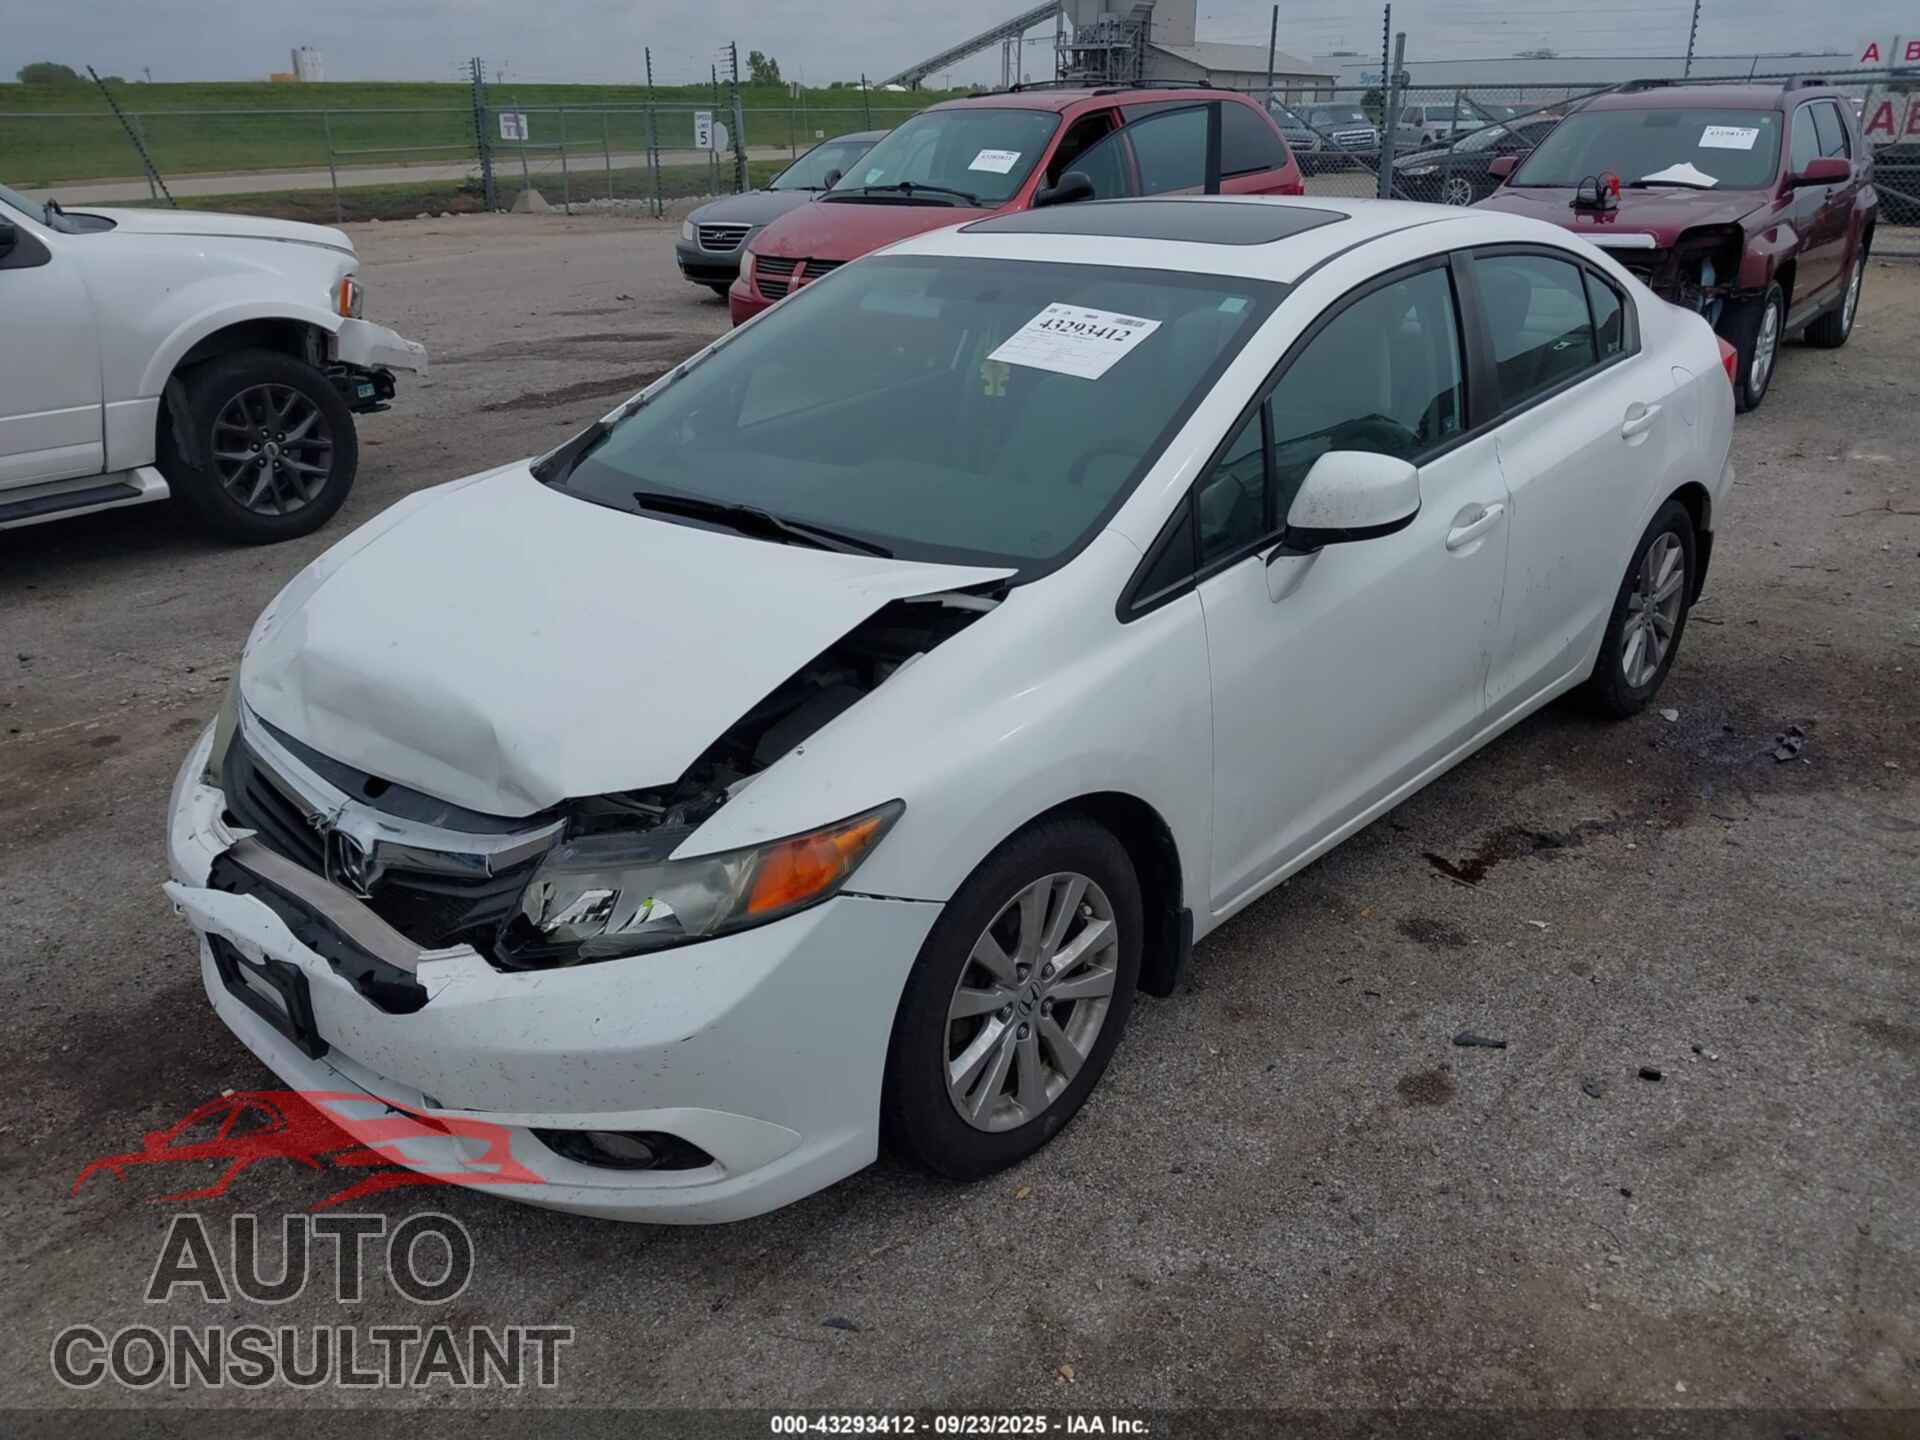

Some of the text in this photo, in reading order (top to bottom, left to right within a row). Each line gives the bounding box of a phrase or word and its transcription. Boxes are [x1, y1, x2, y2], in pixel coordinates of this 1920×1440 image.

[1860, 43, 1879, 62] A
[1864, 101, 1895, 135] A
[700, 131, 707, 144] 5
[1040, 319, 1131, 341] 43293412
